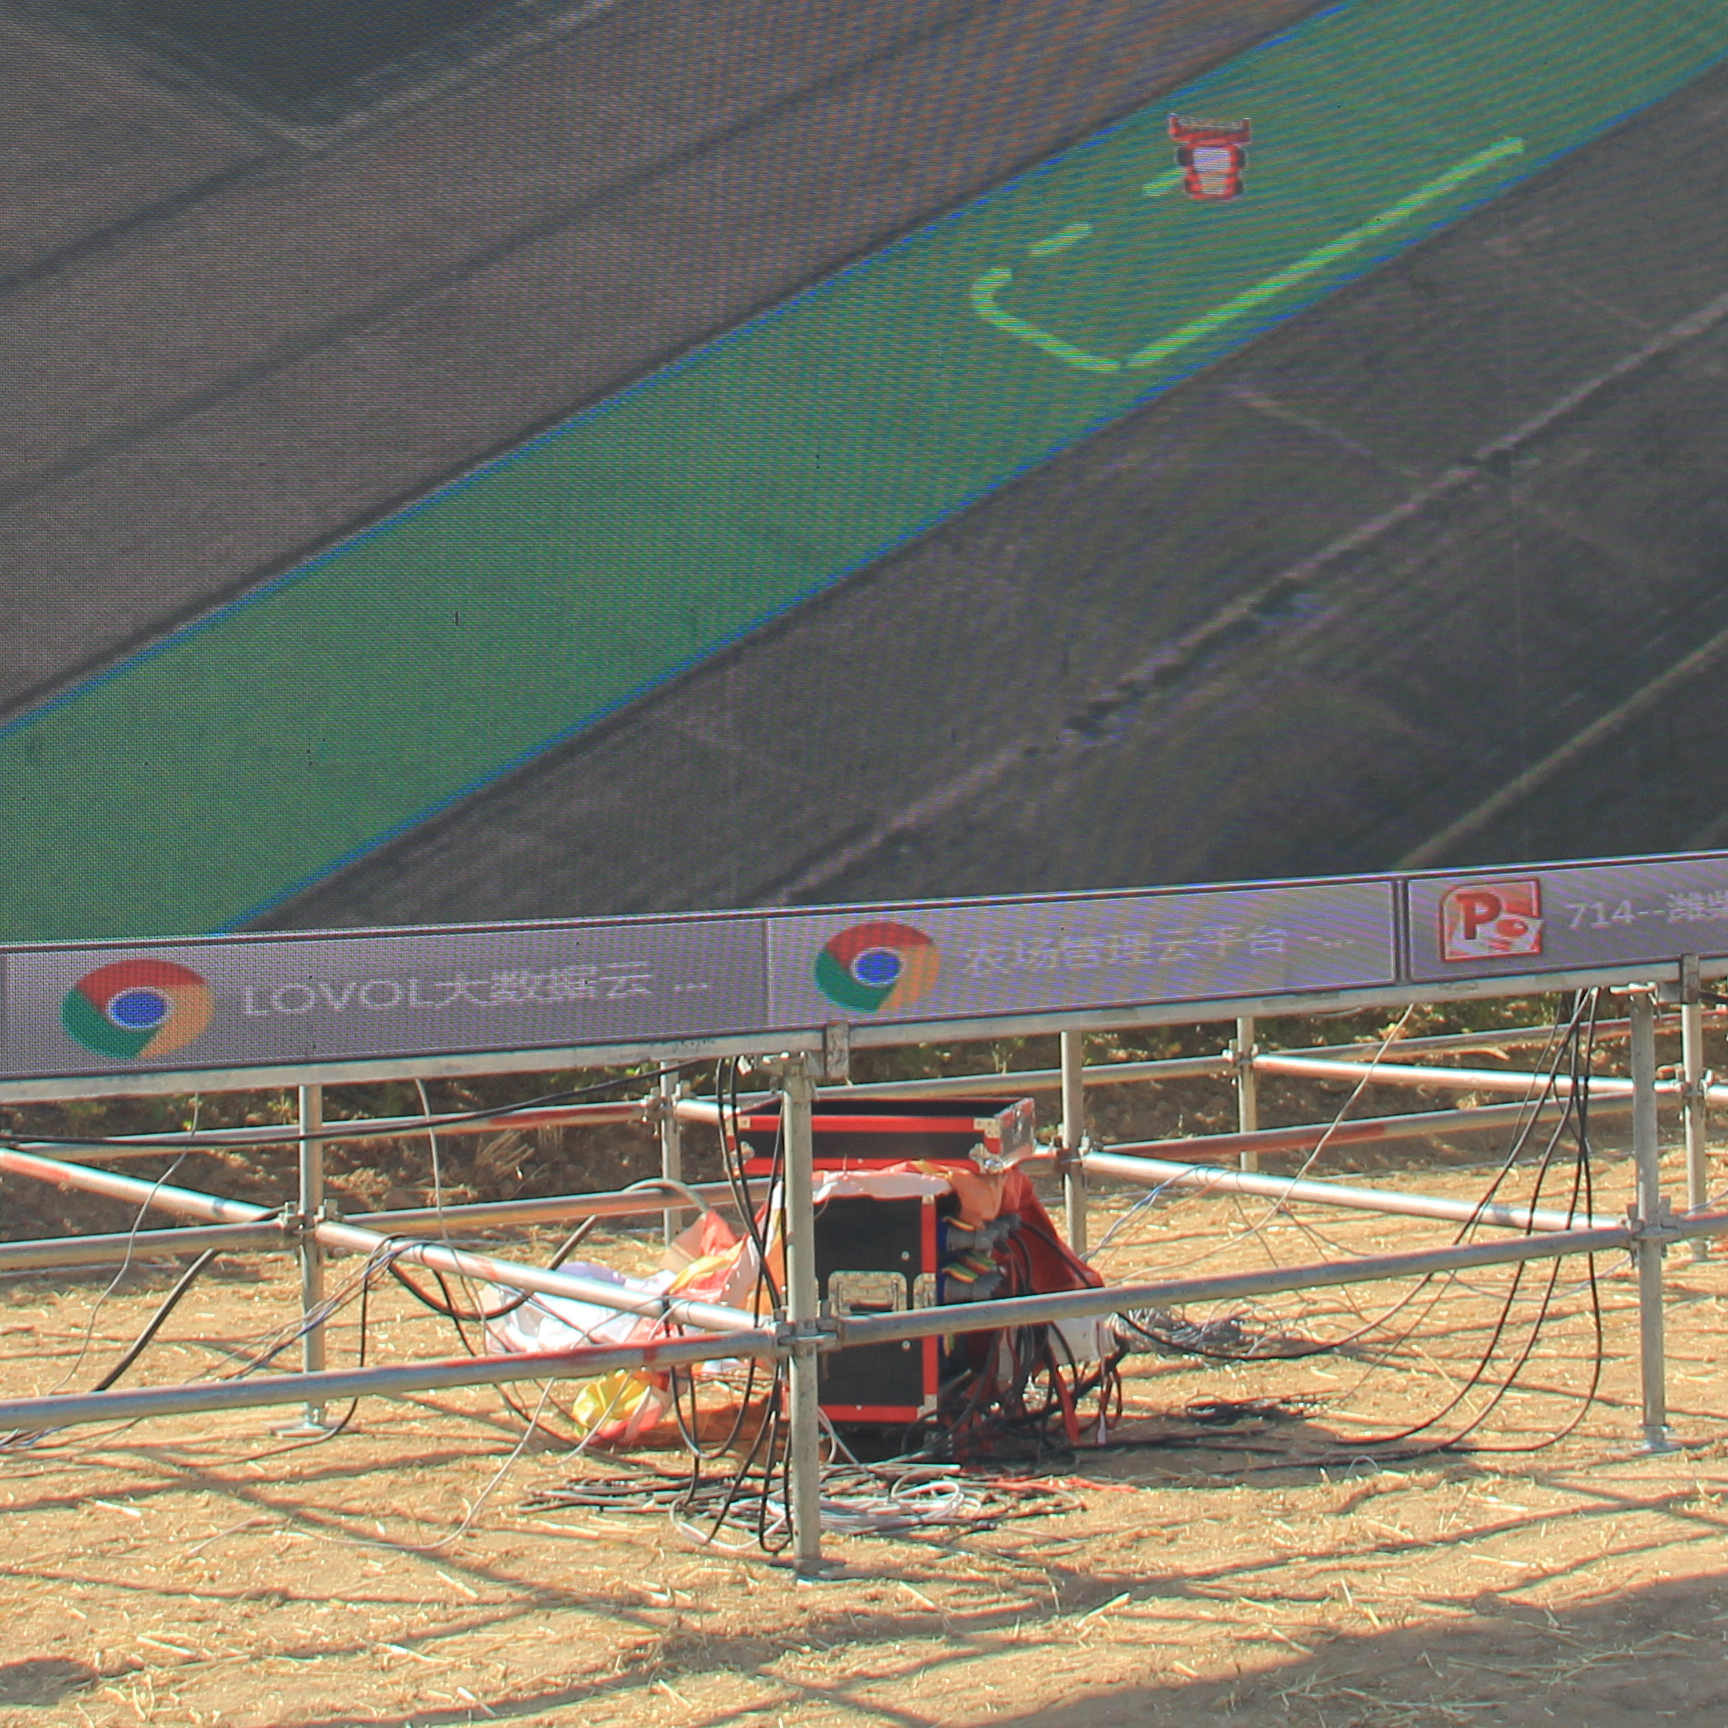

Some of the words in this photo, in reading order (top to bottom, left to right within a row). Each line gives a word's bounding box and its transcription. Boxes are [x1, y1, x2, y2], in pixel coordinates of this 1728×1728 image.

[966, 925, 1287, 978] 农场管理云平台
[241, 960, 653, 1019] LOVOL大数据云
